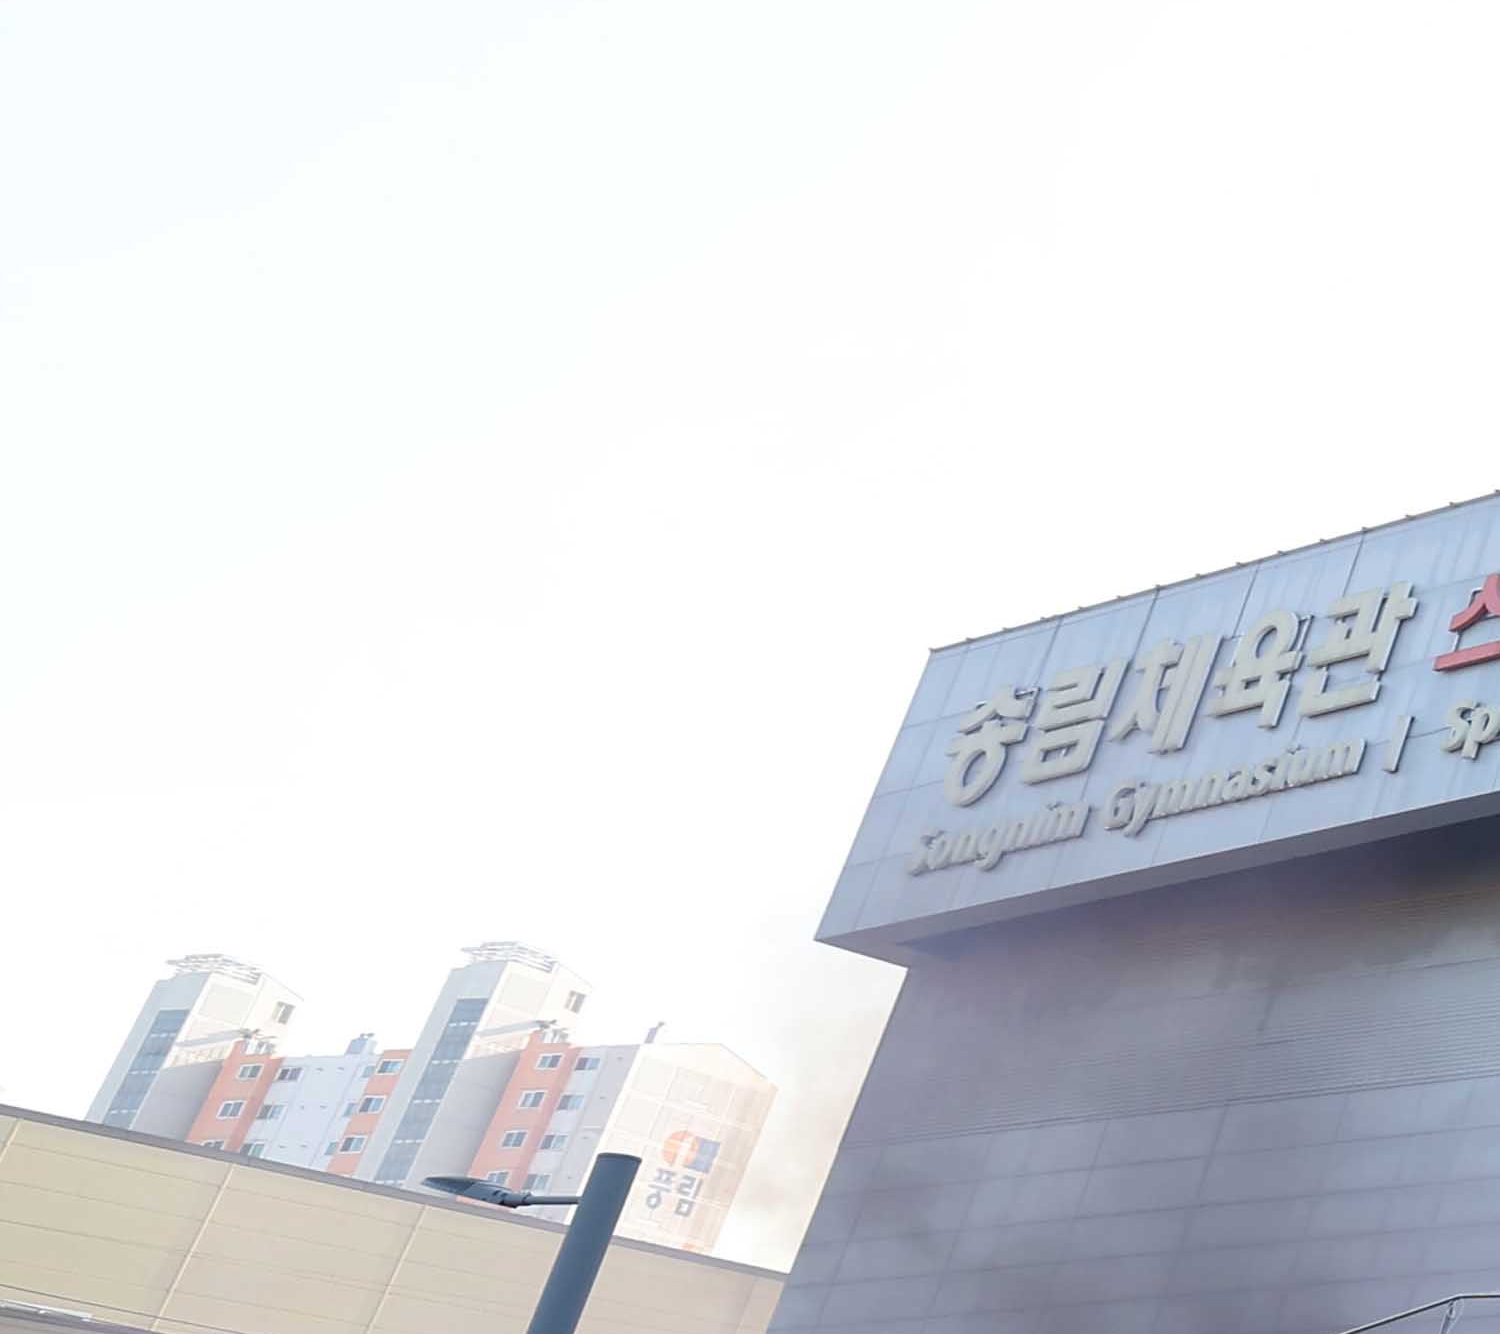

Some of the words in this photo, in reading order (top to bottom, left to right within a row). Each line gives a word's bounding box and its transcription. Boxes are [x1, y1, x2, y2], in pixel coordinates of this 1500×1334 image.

[944, 581, 1418, 807] 송림체육관
[911, 799, 1092, 875] Songnim
[1105, 737, 1366, 837] Gymnasium
[646, 1168, 704, 1217] 풍림
